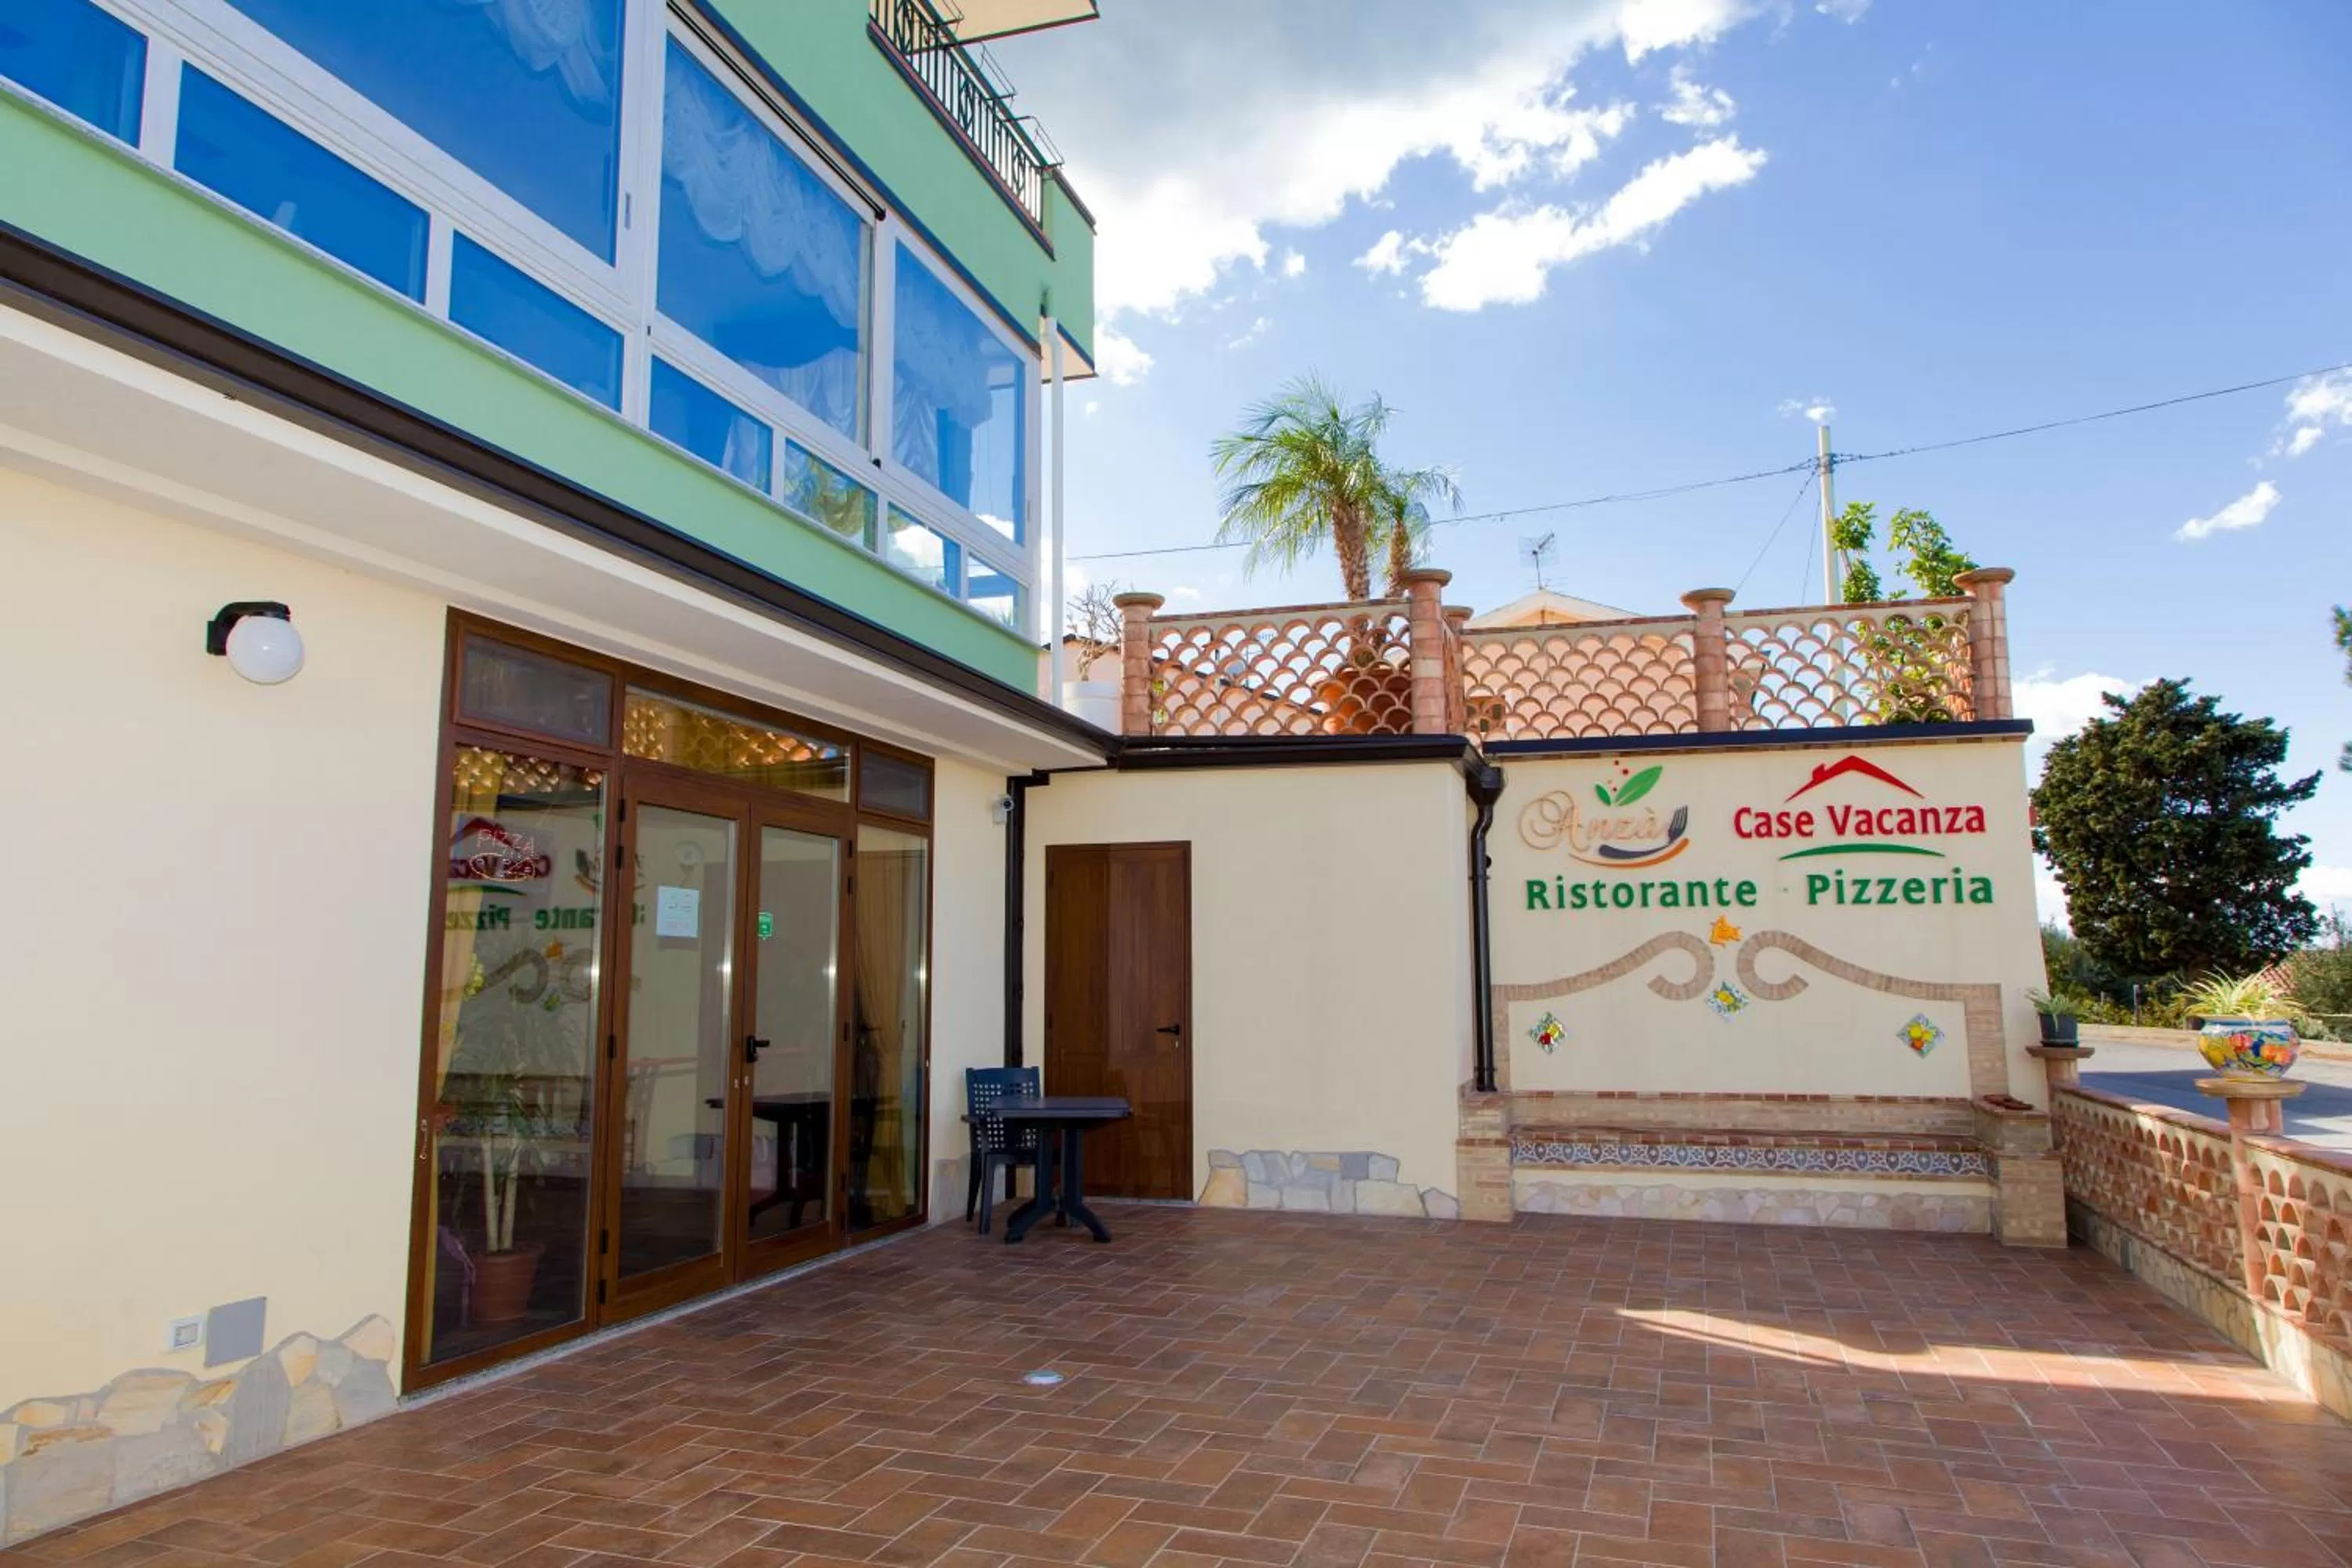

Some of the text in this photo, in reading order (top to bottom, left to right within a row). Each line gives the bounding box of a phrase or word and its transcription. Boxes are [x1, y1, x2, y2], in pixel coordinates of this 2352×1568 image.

[1733, 804, 1987, 839] Case Vacanza
[1525, 866, 1994, 911] Ristorante Pizzeria
